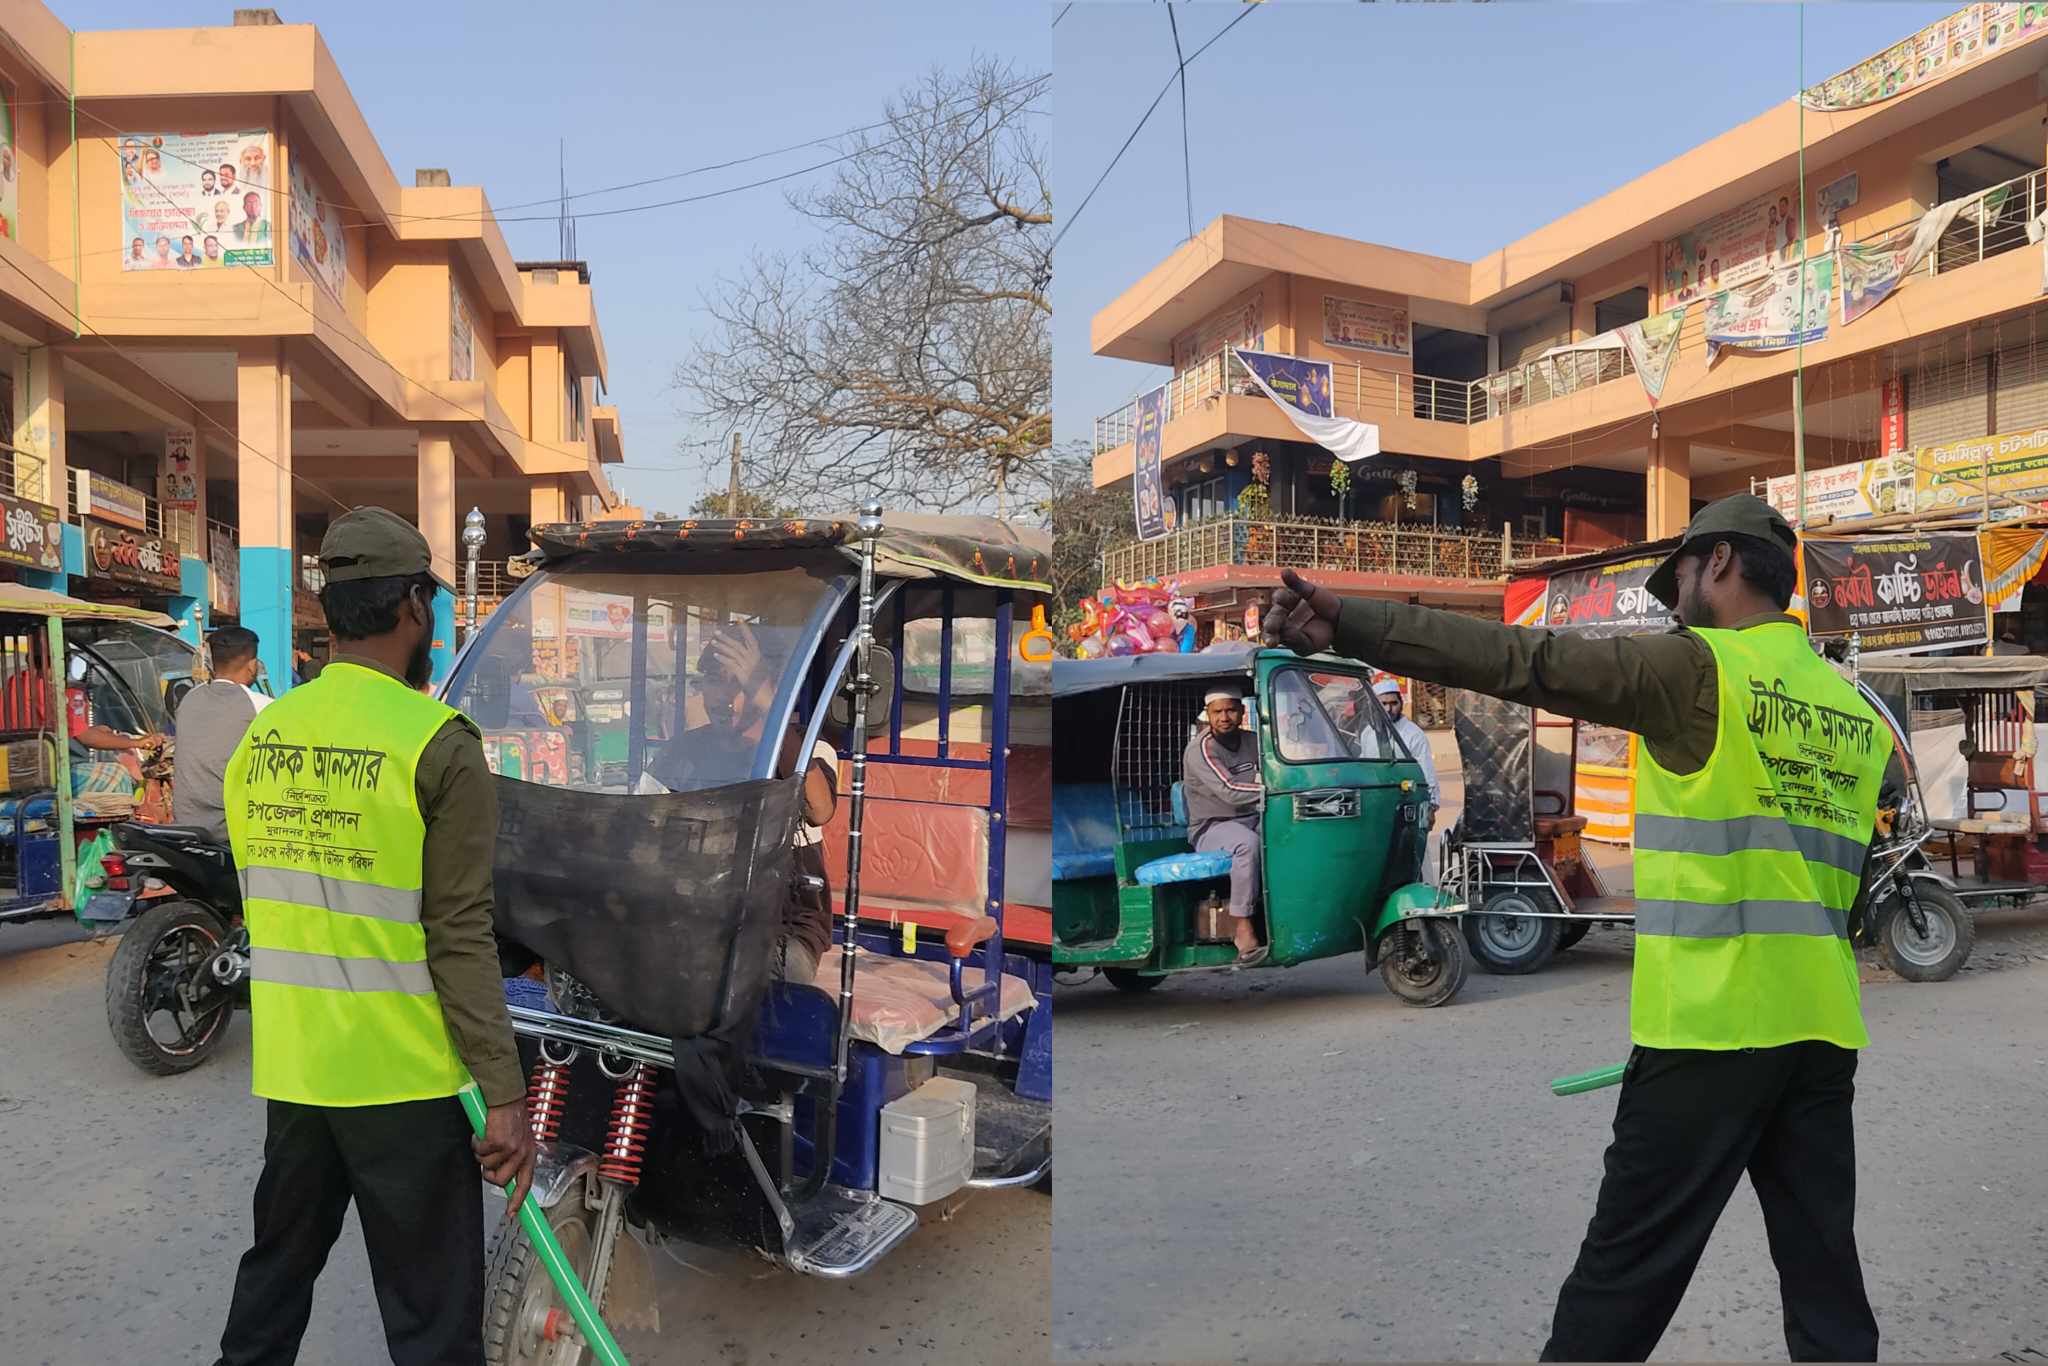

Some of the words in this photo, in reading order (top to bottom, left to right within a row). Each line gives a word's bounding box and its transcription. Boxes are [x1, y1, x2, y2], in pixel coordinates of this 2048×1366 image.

[1874, 553, 1922, 605] কাচ্চি
[1747, 674, 1812, 740] ট্রাফিক
[1813, 704, 1874, 760] আনসার
[312, 742, 387, 792] আনসার
[248, 800, 307, 826] উপজেলা
[311, 807, 362, 832] প্রশাসন
